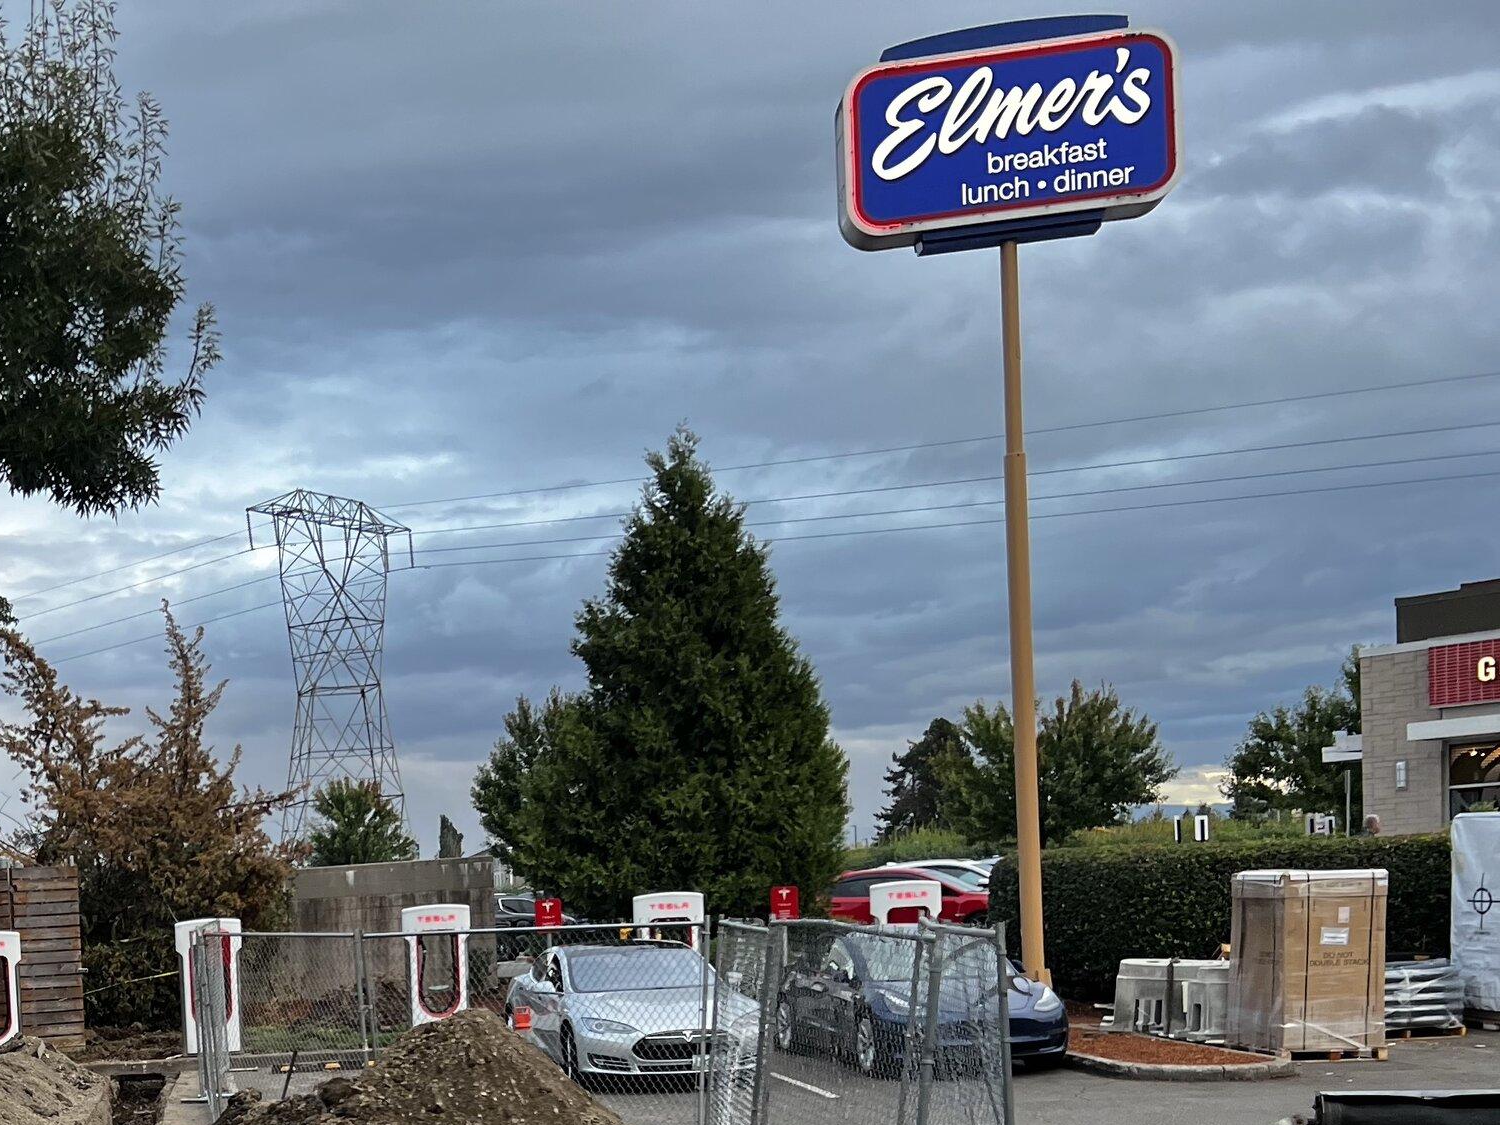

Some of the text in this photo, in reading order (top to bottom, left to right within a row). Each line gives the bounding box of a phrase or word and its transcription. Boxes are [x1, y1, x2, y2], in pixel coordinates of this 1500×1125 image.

[871, 48, 1151, 181] Elmer's
[987, 138, 1108, 174] breakfast
[961, 164, 1135, 206] lunch dinner
[649, 902, 690, 910] TESLA
[888, 891, 928, 900] TESLA
[417, 915, 456, 923] TESLA
